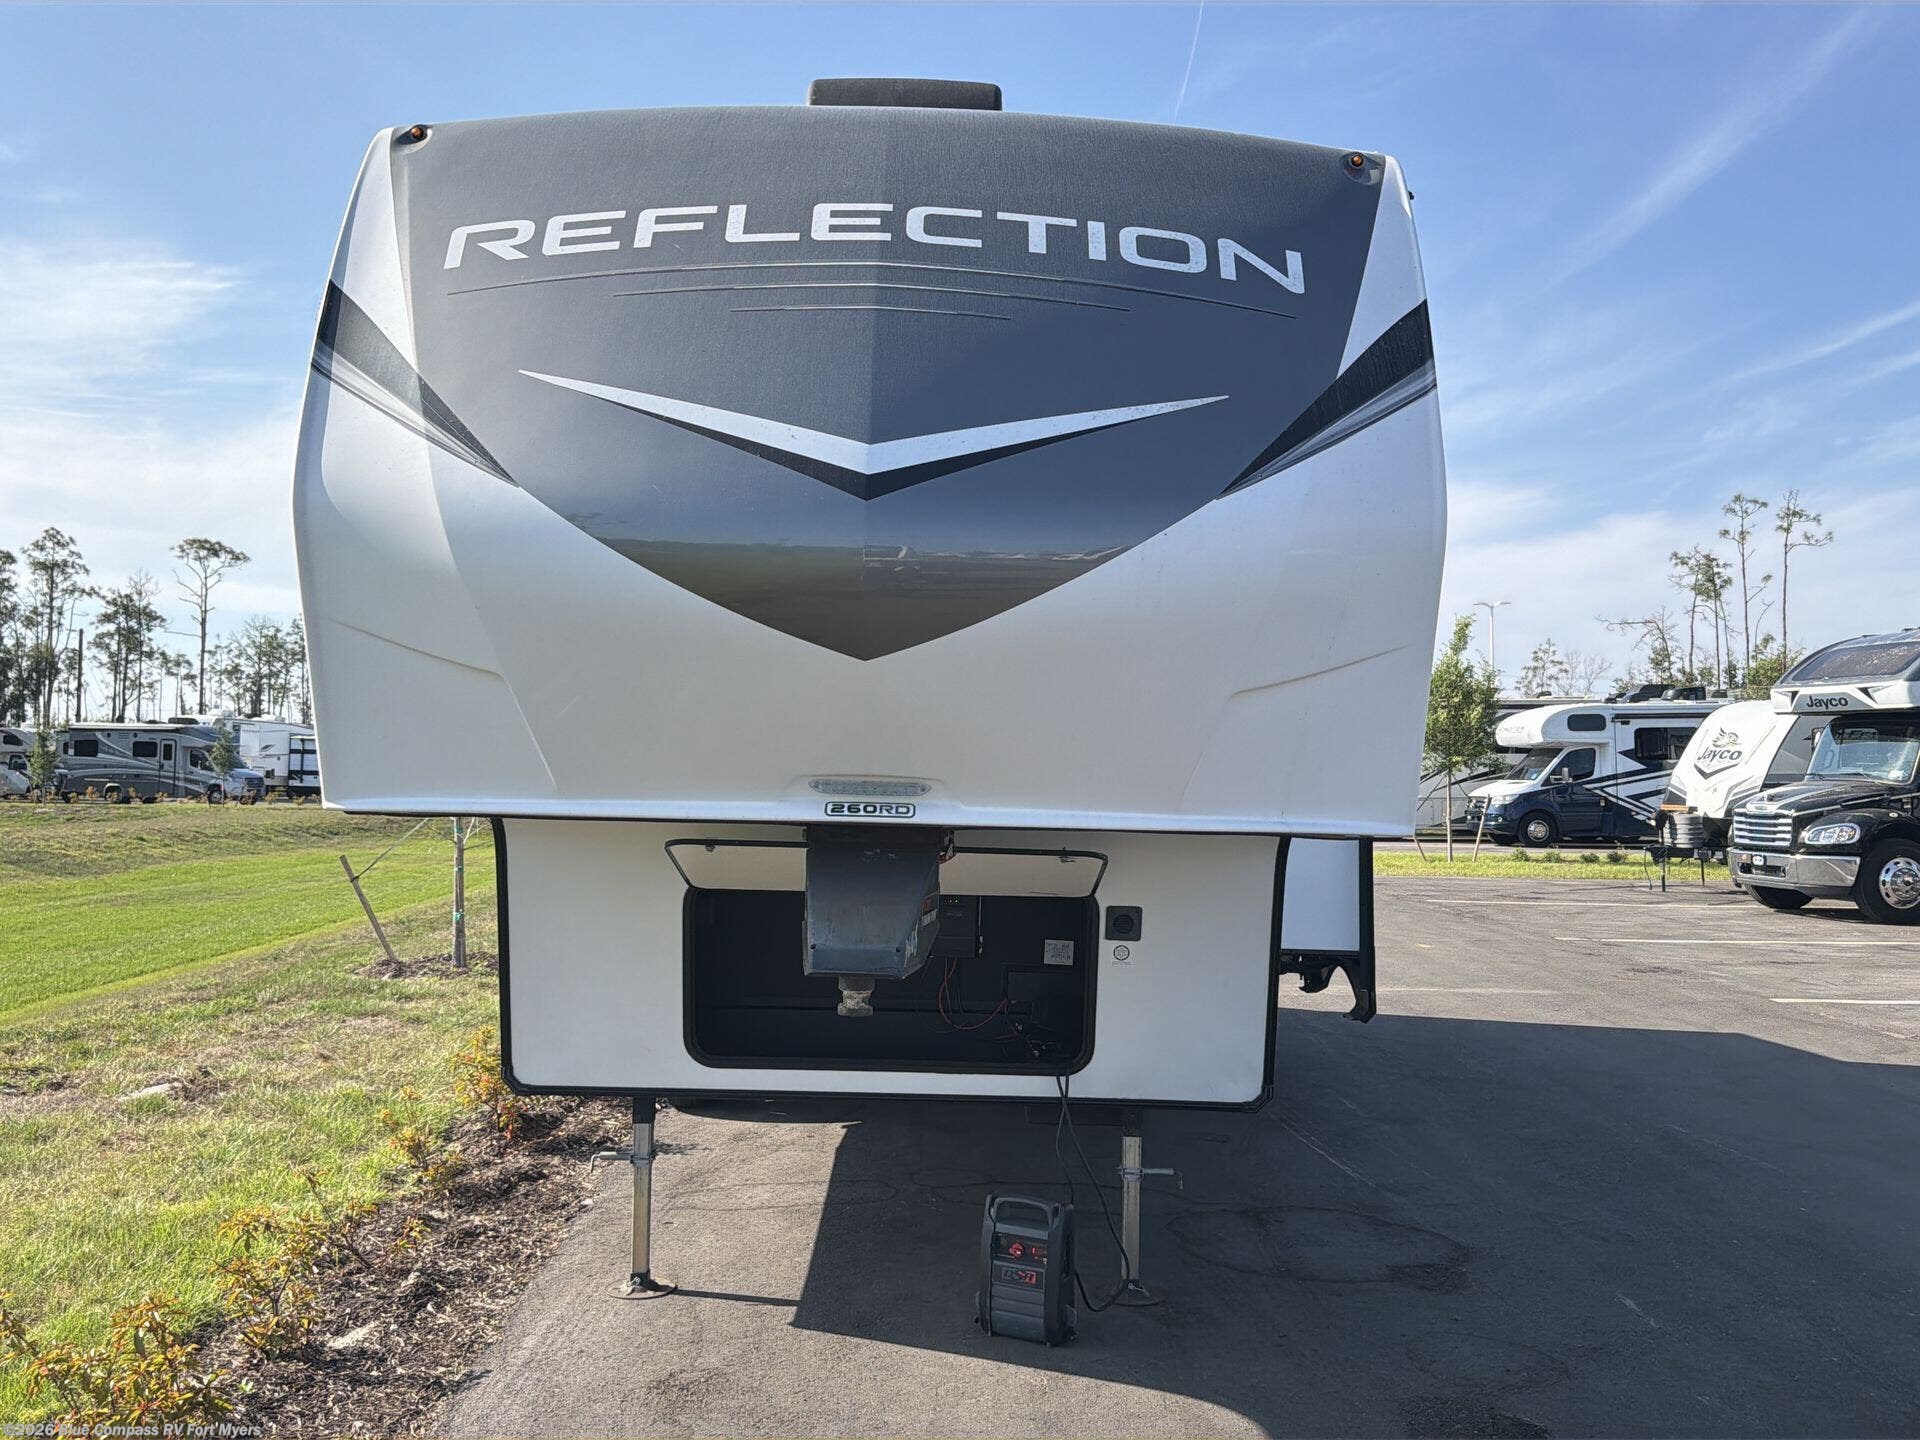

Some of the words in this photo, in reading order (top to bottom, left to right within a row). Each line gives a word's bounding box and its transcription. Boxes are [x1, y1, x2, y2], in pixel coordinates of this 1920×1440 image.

[444, 203, 1305, 295] REFLECTION
[1806, 695, 1849, 709] Jayco
[1697, 746, 1743, 762] Jayco
[830, 803, 911, 815] 260RD
